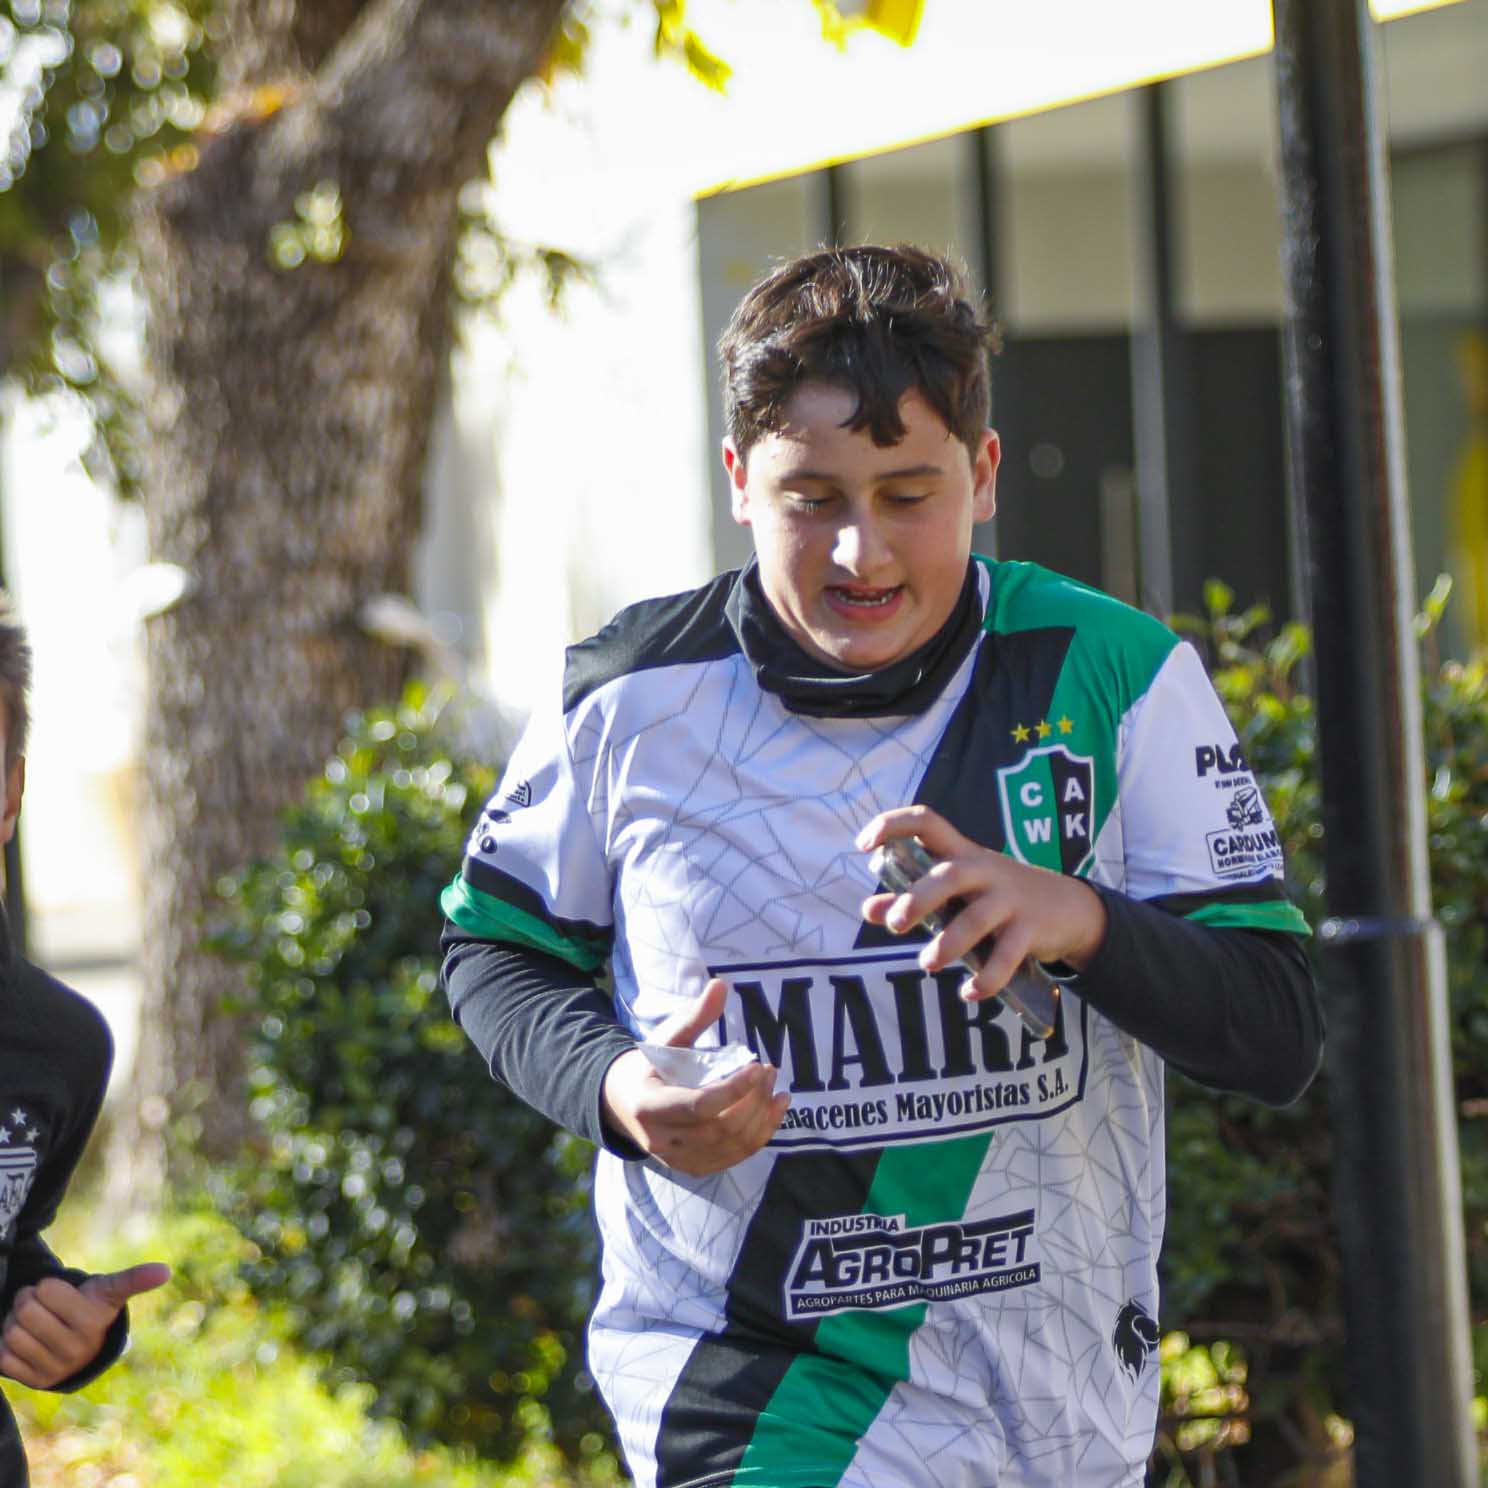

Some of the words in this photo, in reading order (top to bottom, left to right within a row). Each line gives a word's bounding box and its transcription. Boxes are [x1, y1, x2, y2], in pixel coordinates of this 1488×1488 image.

[1020, 781, 1044, 807] C
[1063, 776, 1086, 802] A
[1023, 816, 1052, 844] W
[1065, 812, 1087, 838] K
[778, 1099, 889, 1131] macenes
[895, 1078, 1031, 1123] Mayoristas
[1037, 1068, 1070, 1103] S.A.
[811, 1215, 900, 1236] INDUSTRIA
[797, 1293, 873, 1310] AGROPARTES
[875, 1287, 906, 1303] PARA
[982, 1268, 1037, 1290] AGRICOLA
